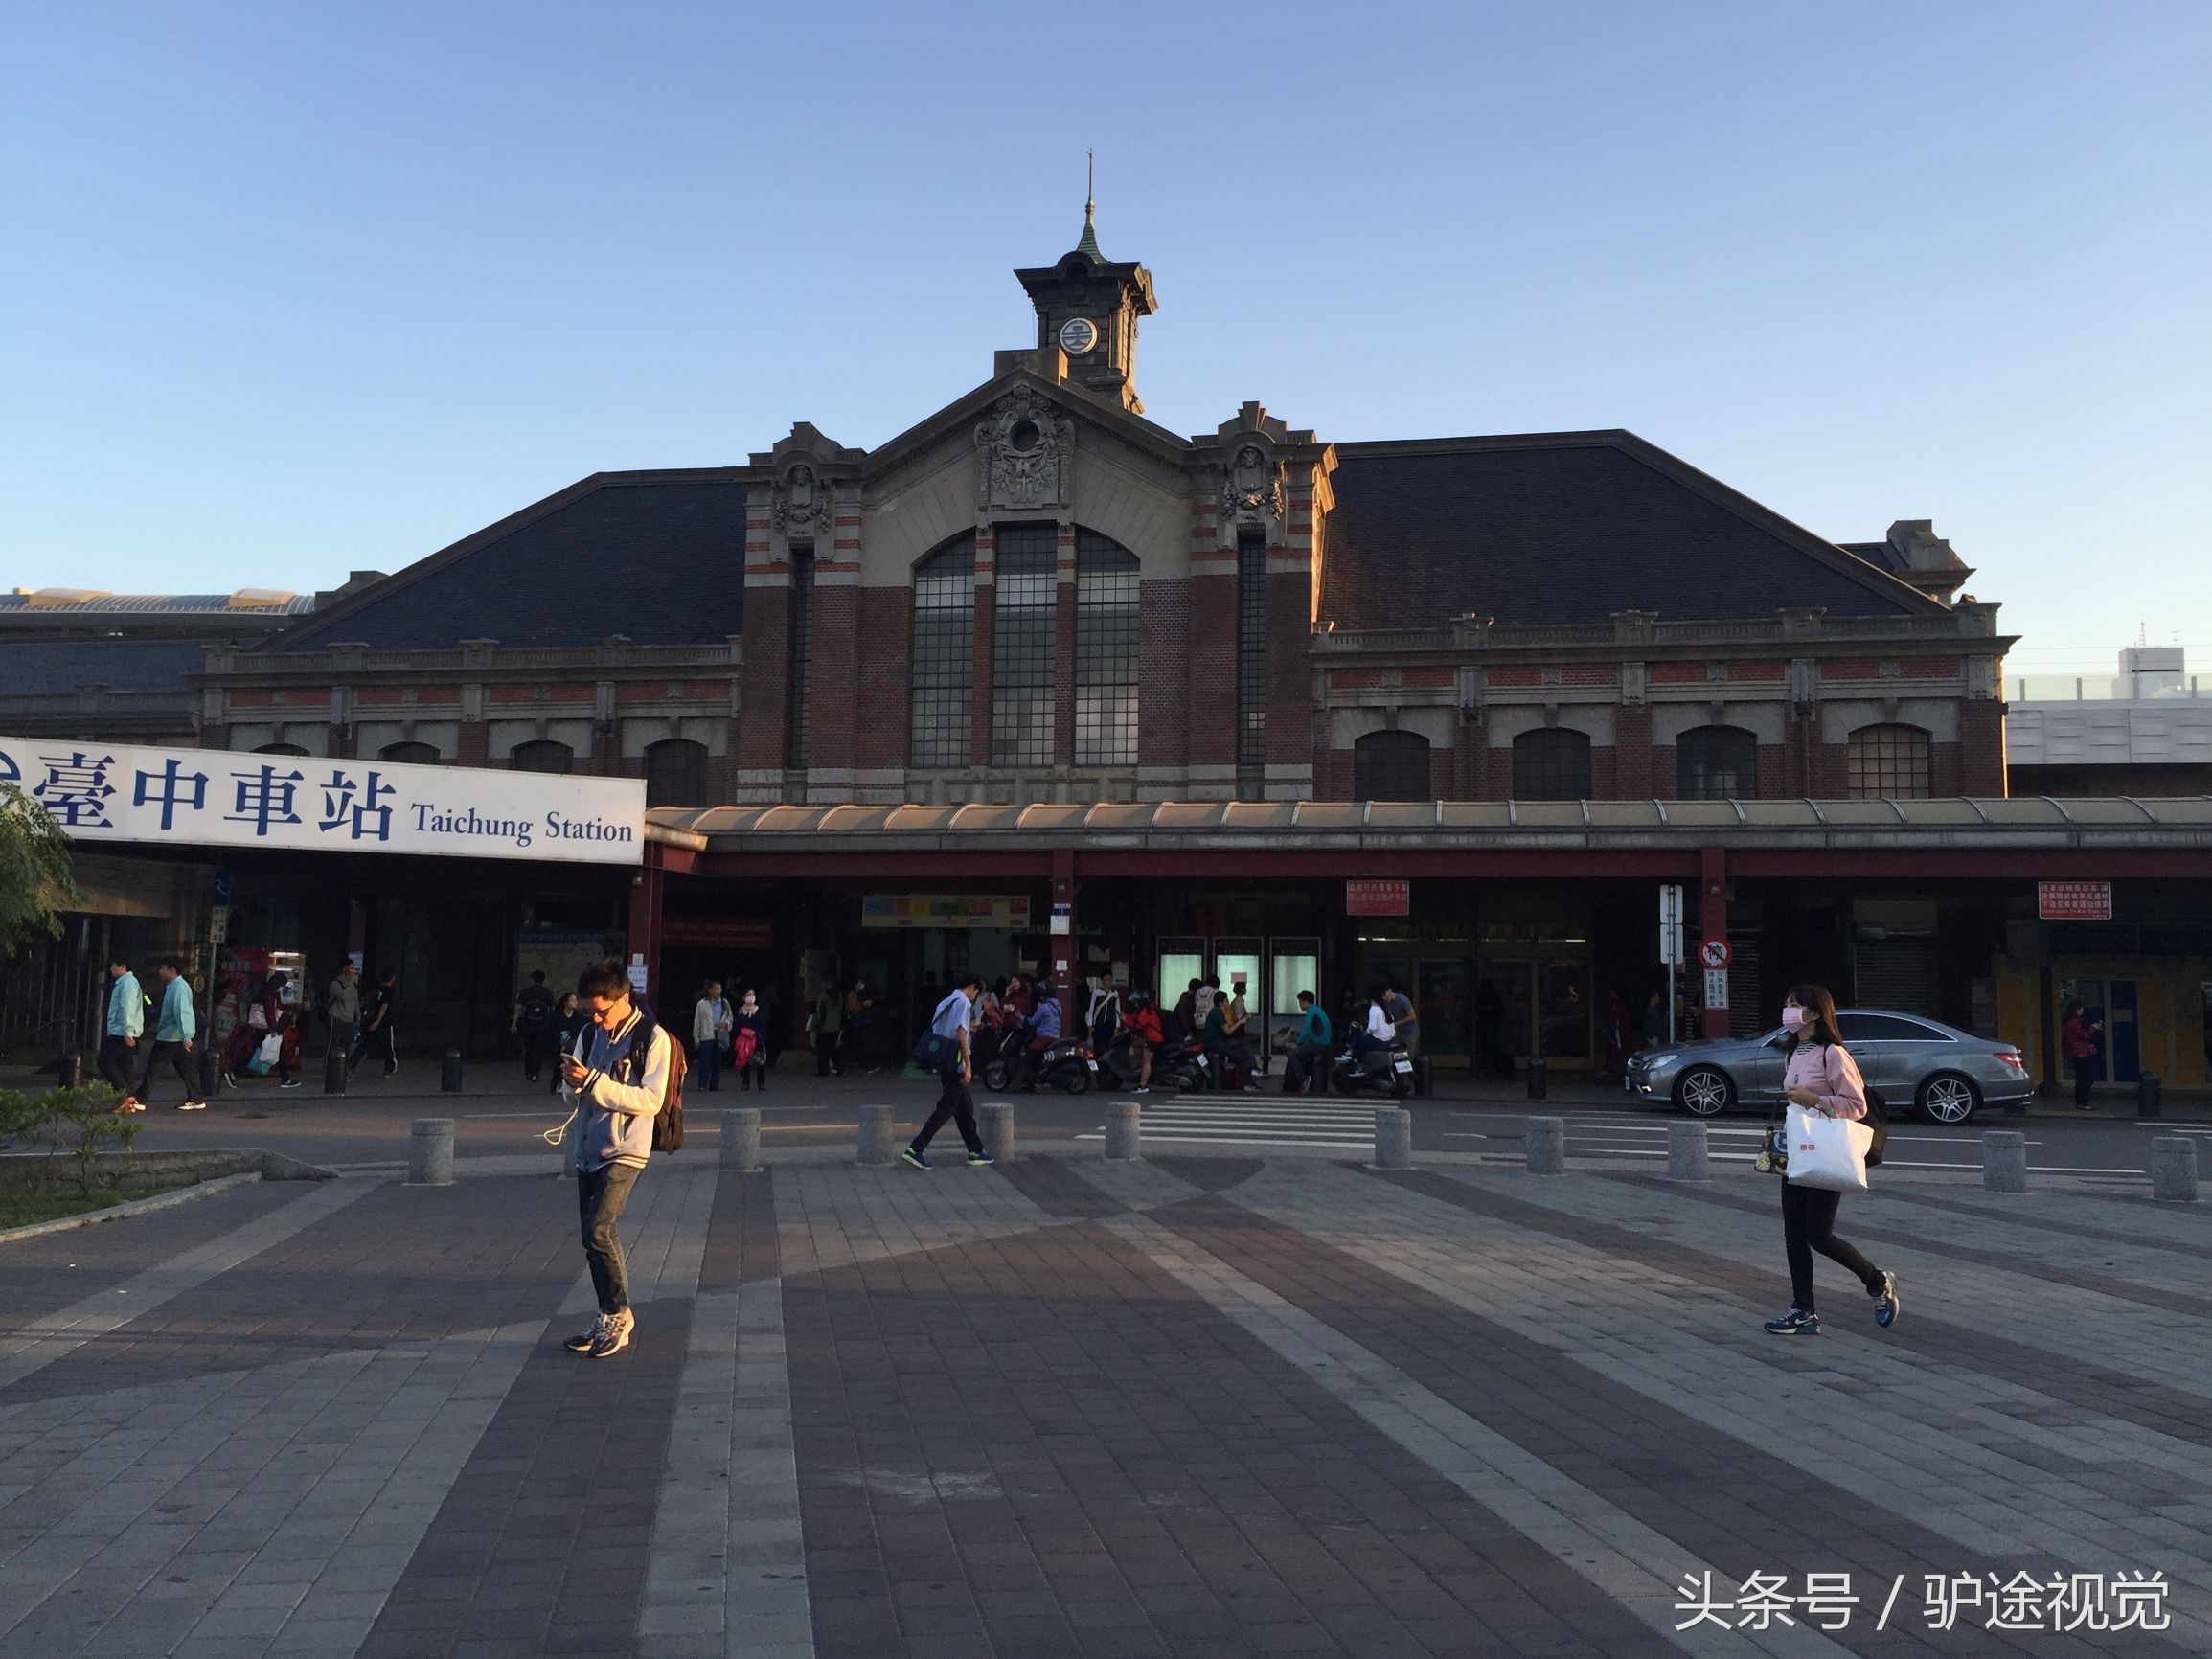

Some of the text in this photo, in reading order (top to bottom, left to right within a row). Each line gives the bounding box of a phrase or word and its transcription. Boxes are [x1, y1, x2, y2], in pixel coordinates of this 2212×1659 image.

[33, 752, 396, 841] 臺中車站
[411, 803, 633, 847] Taichung Station
